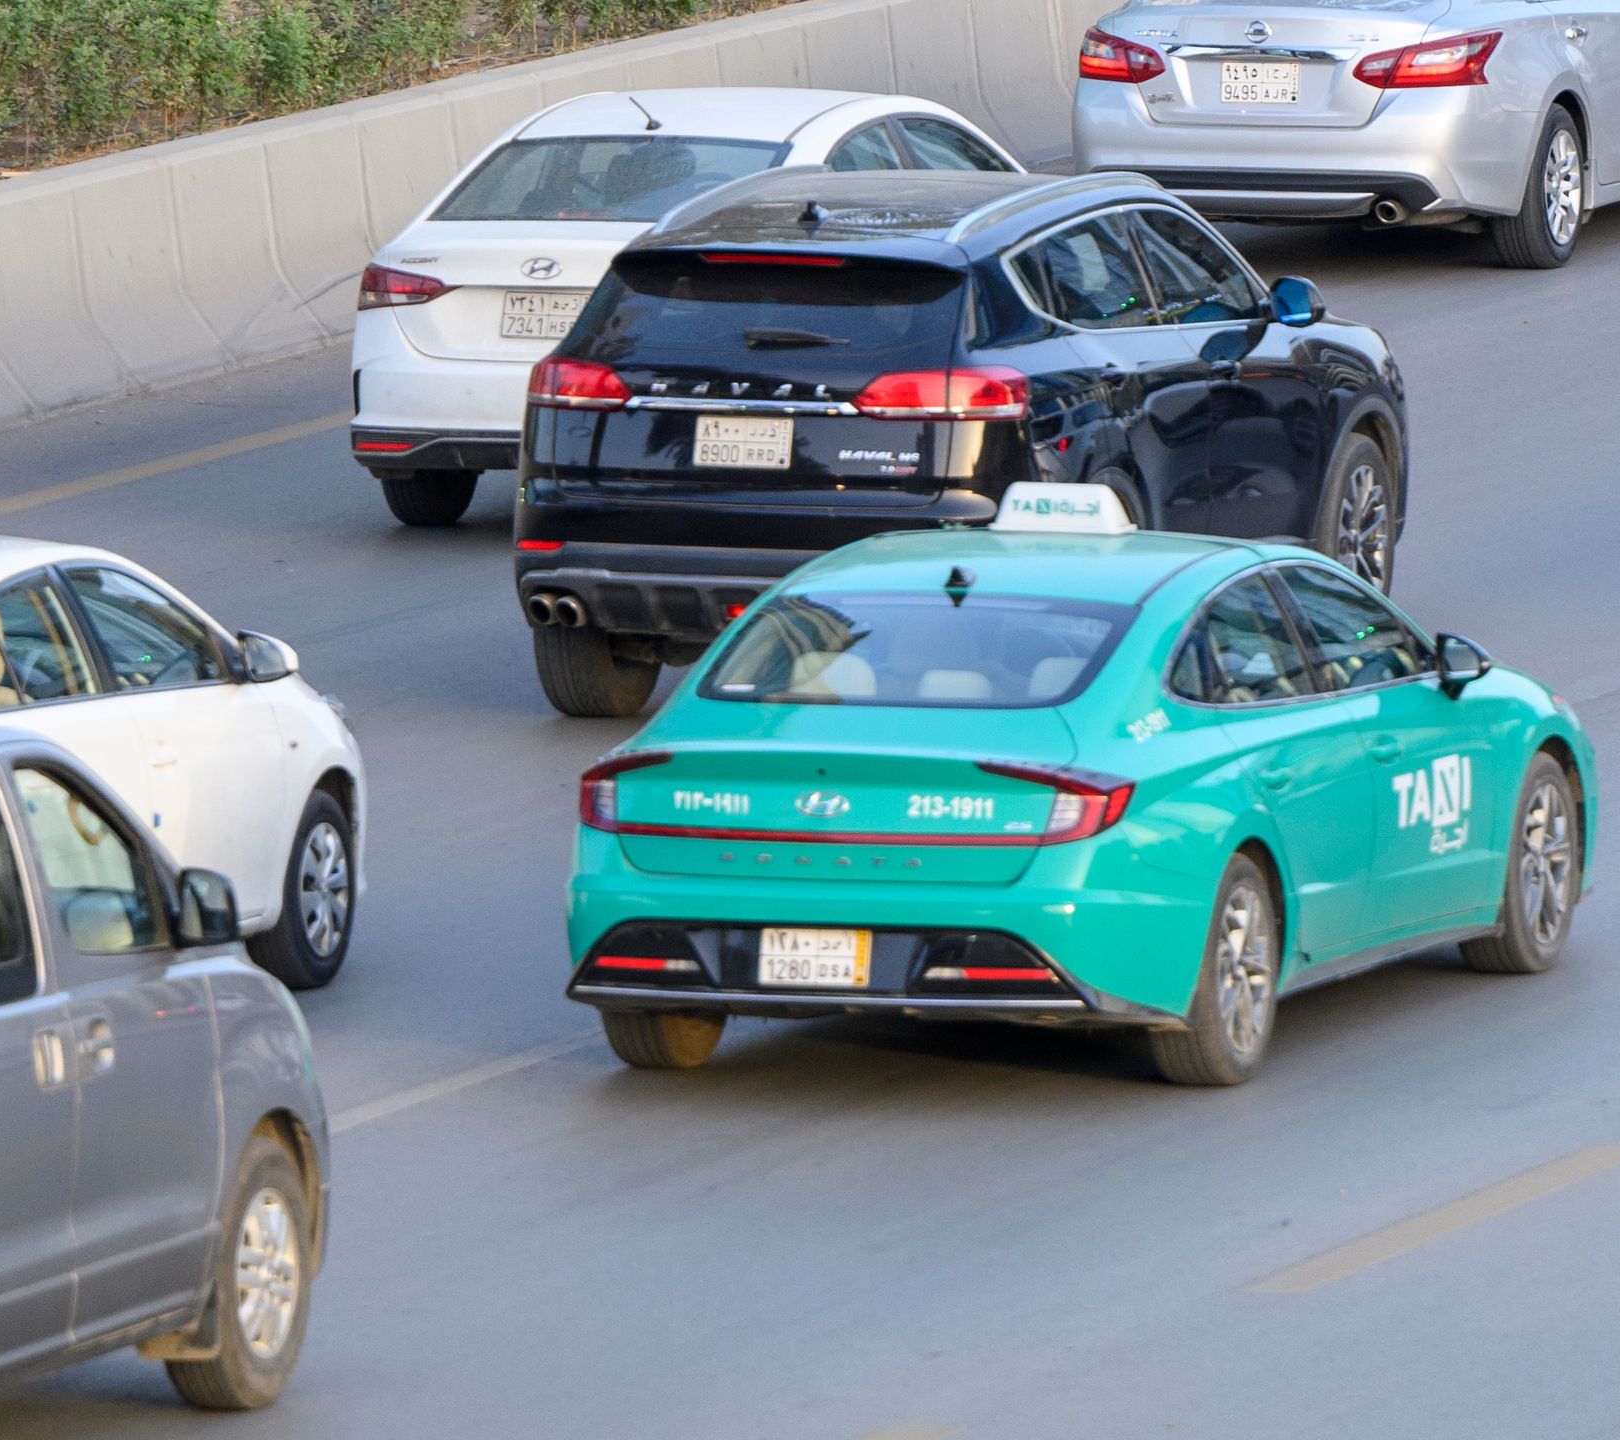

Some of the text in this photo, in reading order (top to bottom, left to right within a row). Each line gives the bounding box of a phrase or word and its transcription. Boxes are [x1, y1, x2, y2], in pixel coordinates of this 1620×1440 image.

[1225, 84, 1288, 101] 9495 AJR
[506, 317, 544, 335] 7341
[651, 382, 830, 399] HAVAL
[700, 443, 776, 464] 8900 RRD
[839, 449, 896, 461] HAVAL
[1392, 753, 1472, 829] TAXI
[906, 793, 994, 819] 213-1911
[766, 958, 855, 981] 1280 DSA
